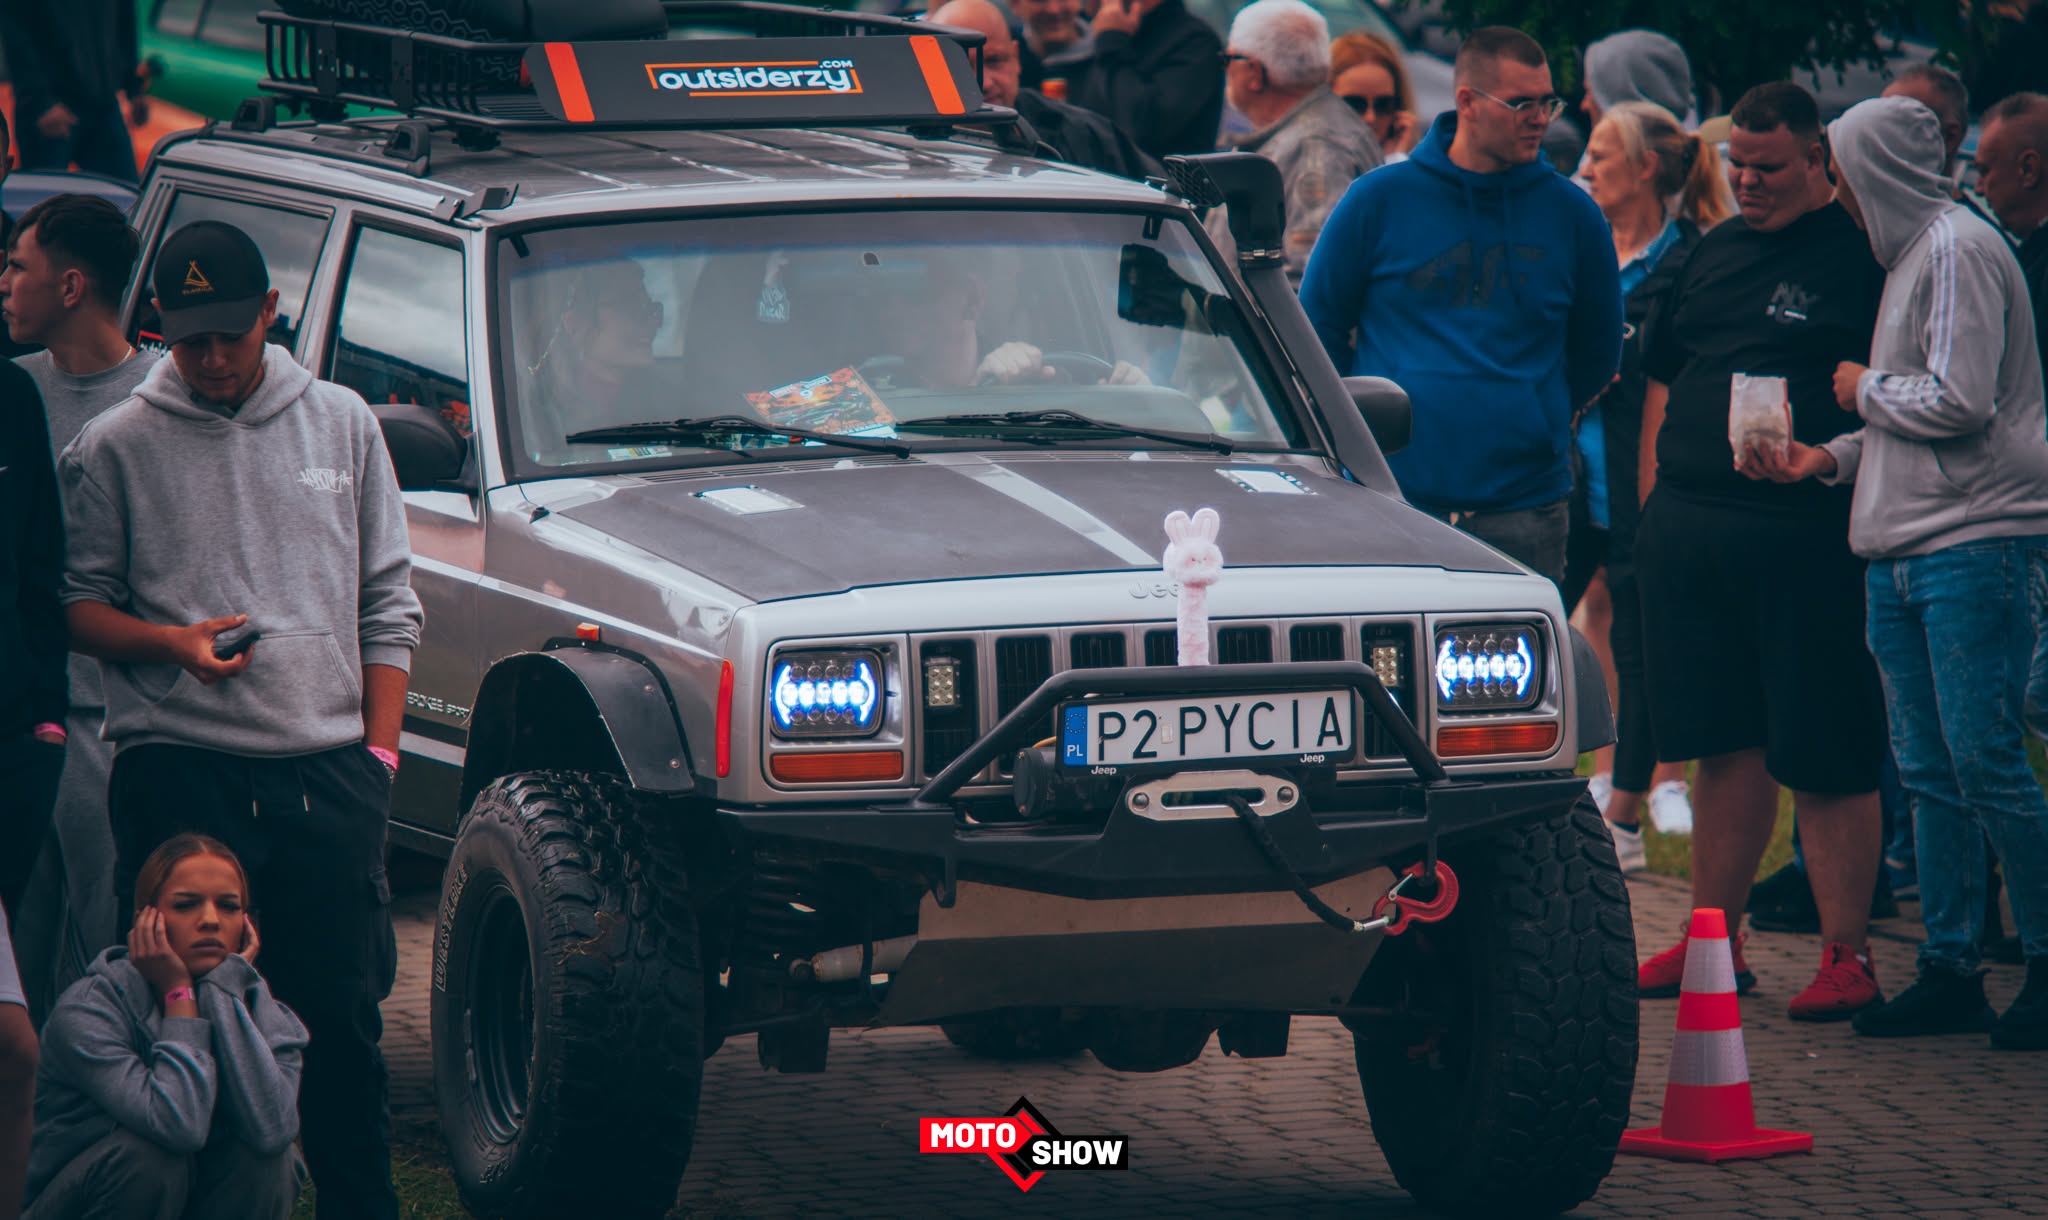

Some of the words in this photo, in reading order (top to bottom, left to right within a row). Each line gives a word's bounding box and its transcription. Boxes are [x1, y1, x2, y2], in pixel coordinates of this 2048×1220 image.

[819, 60, 853, 69] .COM
[659, 66, 851, 92] outsiderzy
[1129, 581, 1178, 599] Jee
[1098, 708, 1158, 761] P2
[1179, 696, 1344, 756] PYCIA
[1066, 744, 1083, 757] PL
[1300, 753, 1325, 763] Jeep
[1091, 765, 1117, 776] Jeep
